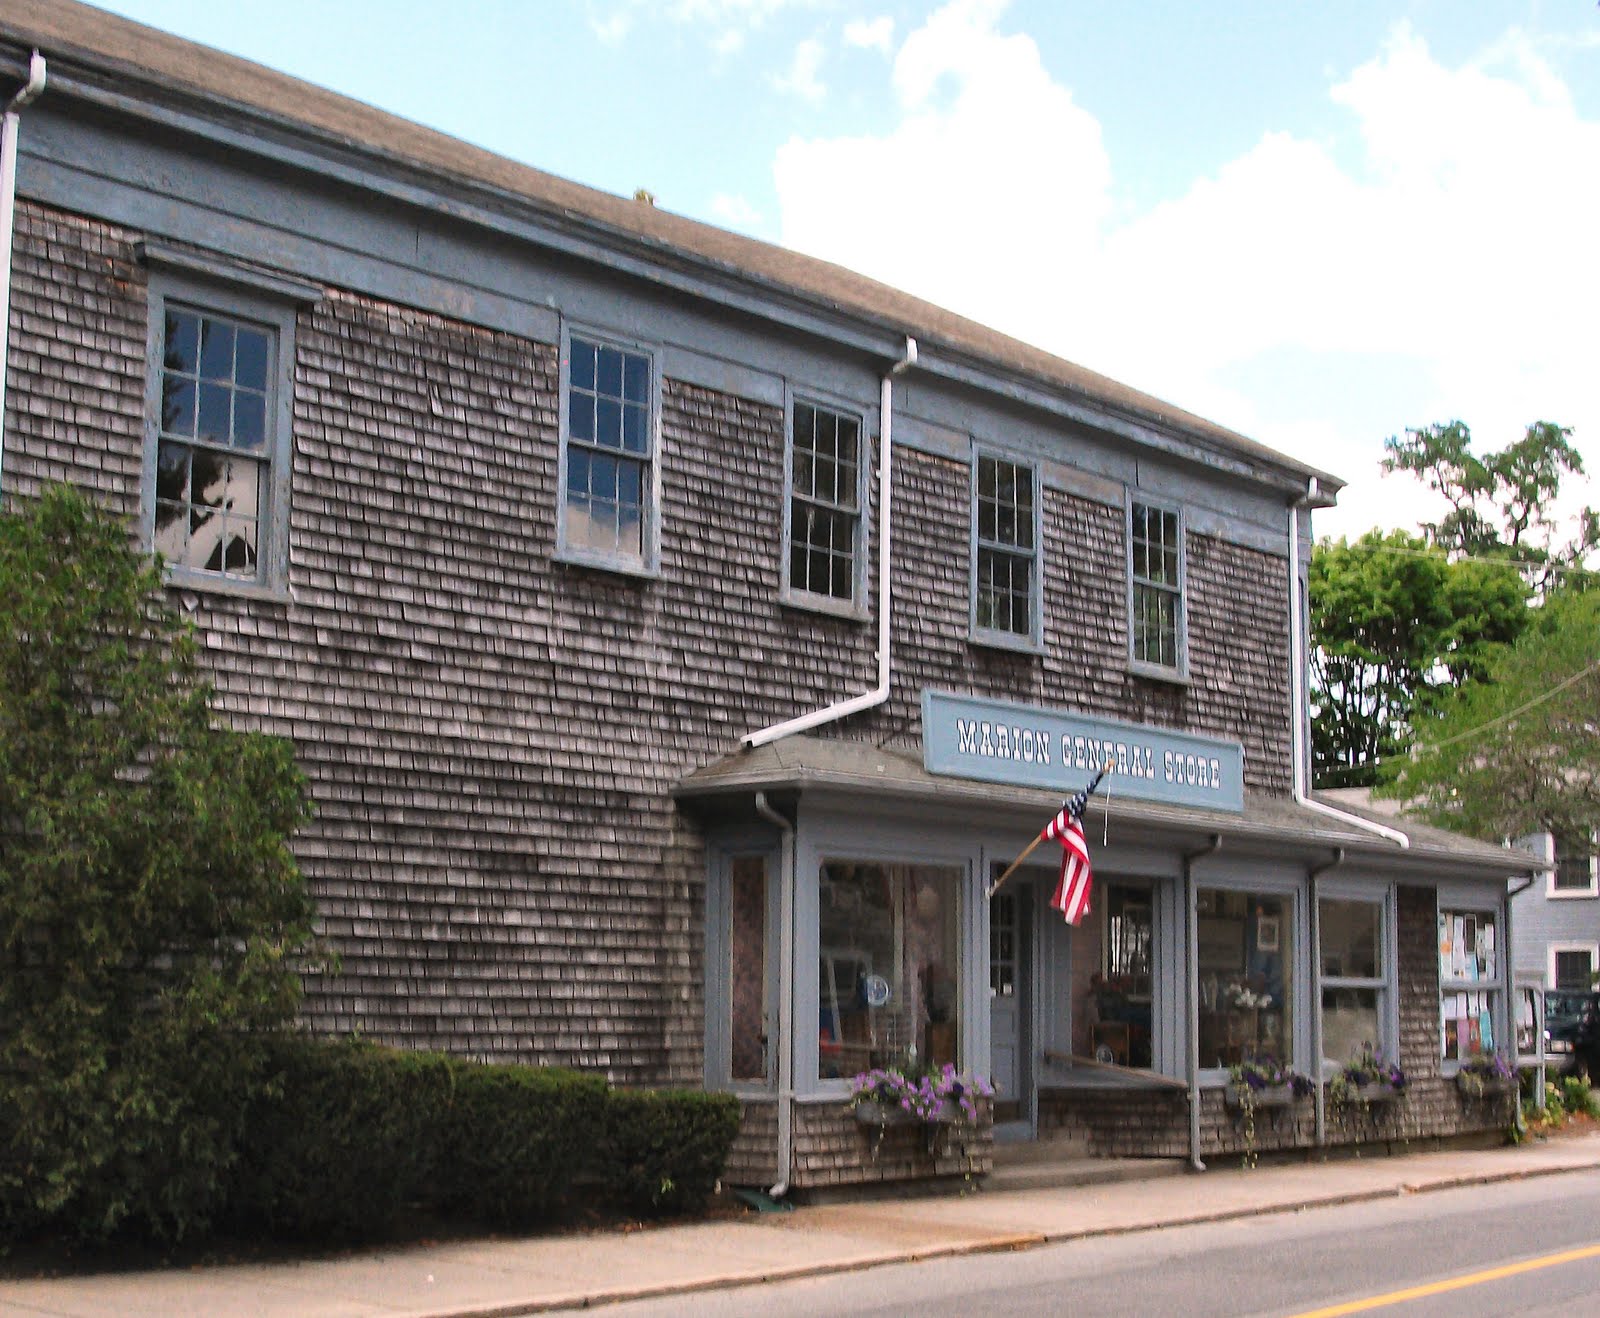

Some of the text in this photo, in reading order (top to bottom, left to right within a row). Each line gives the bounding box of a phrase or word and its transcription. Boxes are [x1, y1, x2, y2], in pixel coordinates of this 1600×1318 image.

[957, 718, 1220, 790] MARION GENERAL STORE
